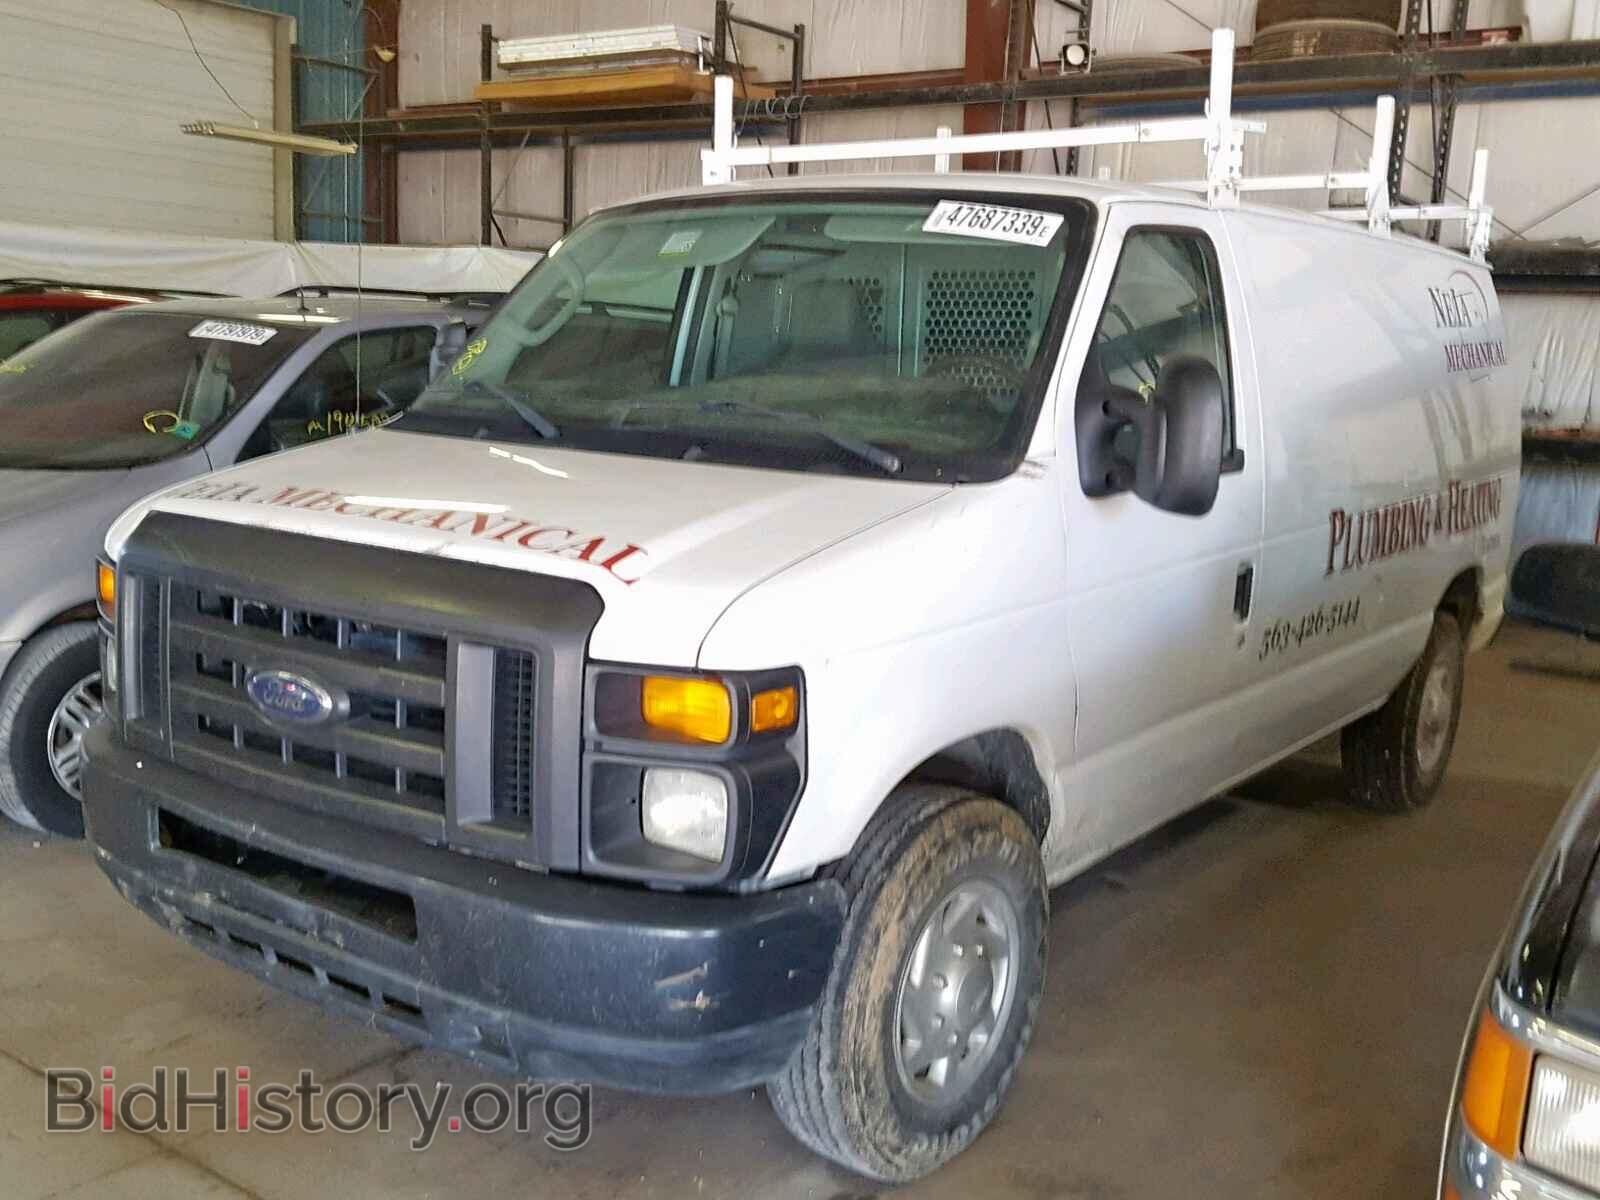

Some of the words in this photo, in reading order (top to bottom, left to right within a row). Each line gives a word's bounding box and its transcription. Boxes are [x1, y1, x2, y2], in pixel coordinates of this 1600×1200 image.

[1444, 341, 1507, 373] MECHANICAL
[268, 486, 648, 586] MECHANICAL
[1325, 495, 1431, 577] PLUMBING
